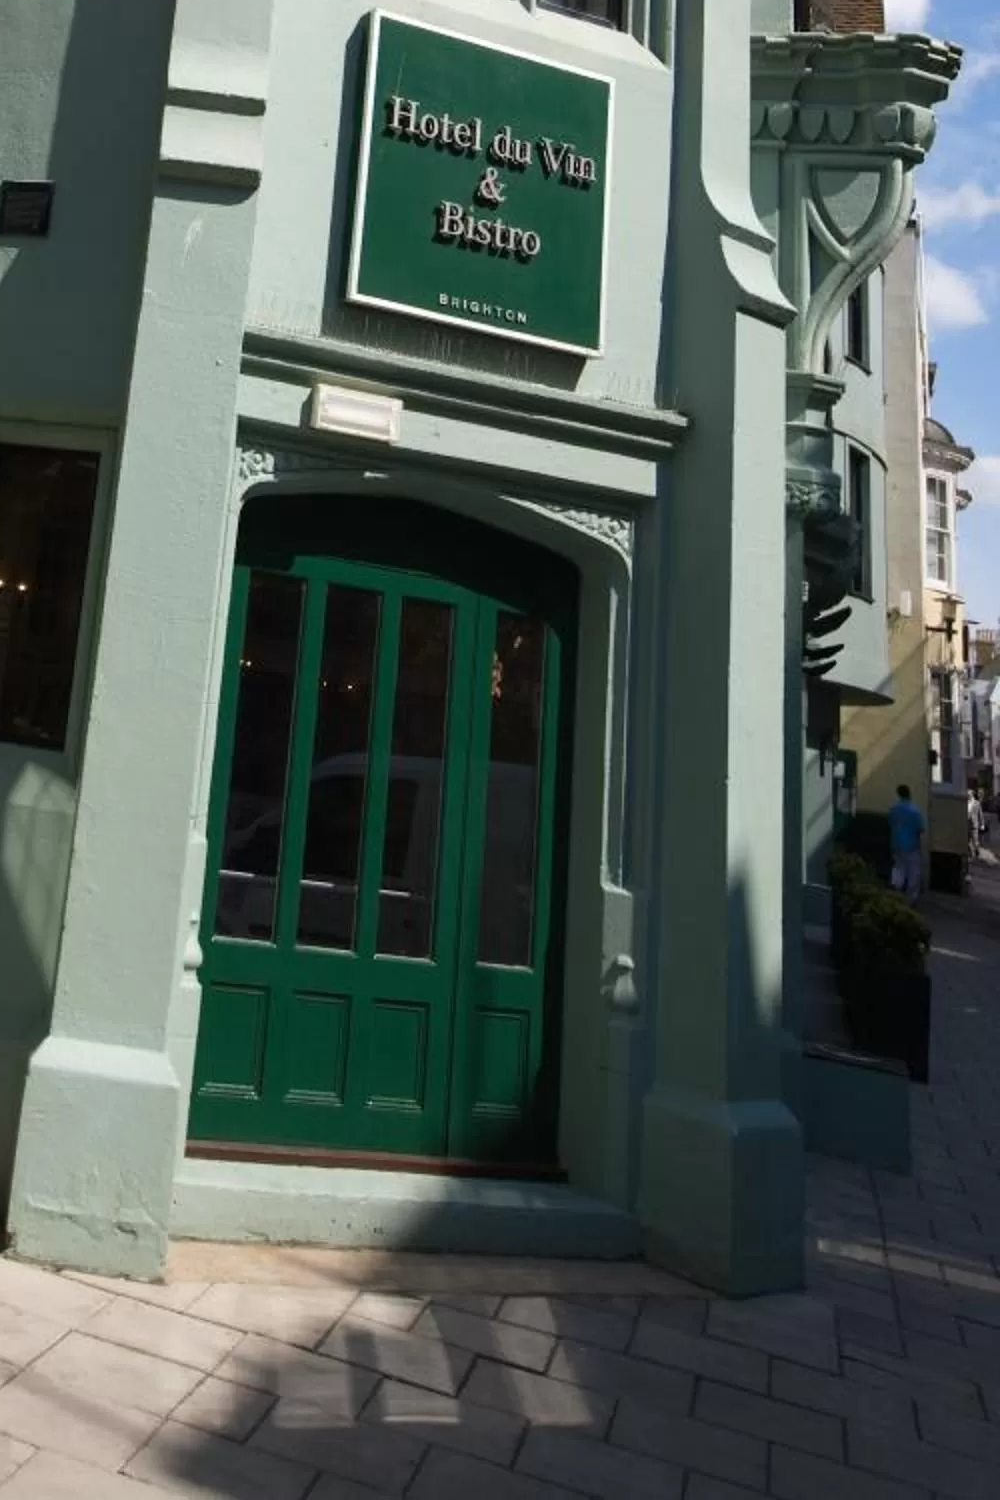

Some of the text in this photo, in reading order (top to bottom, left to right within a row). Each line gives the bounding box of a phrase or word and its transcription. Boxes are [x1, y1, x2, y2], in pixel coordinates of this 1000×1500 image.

[389, 95, 597, 182] Hotel du Vin
[479, 166, 508, 202] &
[440, 200, 542, 257] Bistro
[439, 293, 528, 324] BRIGHTON
